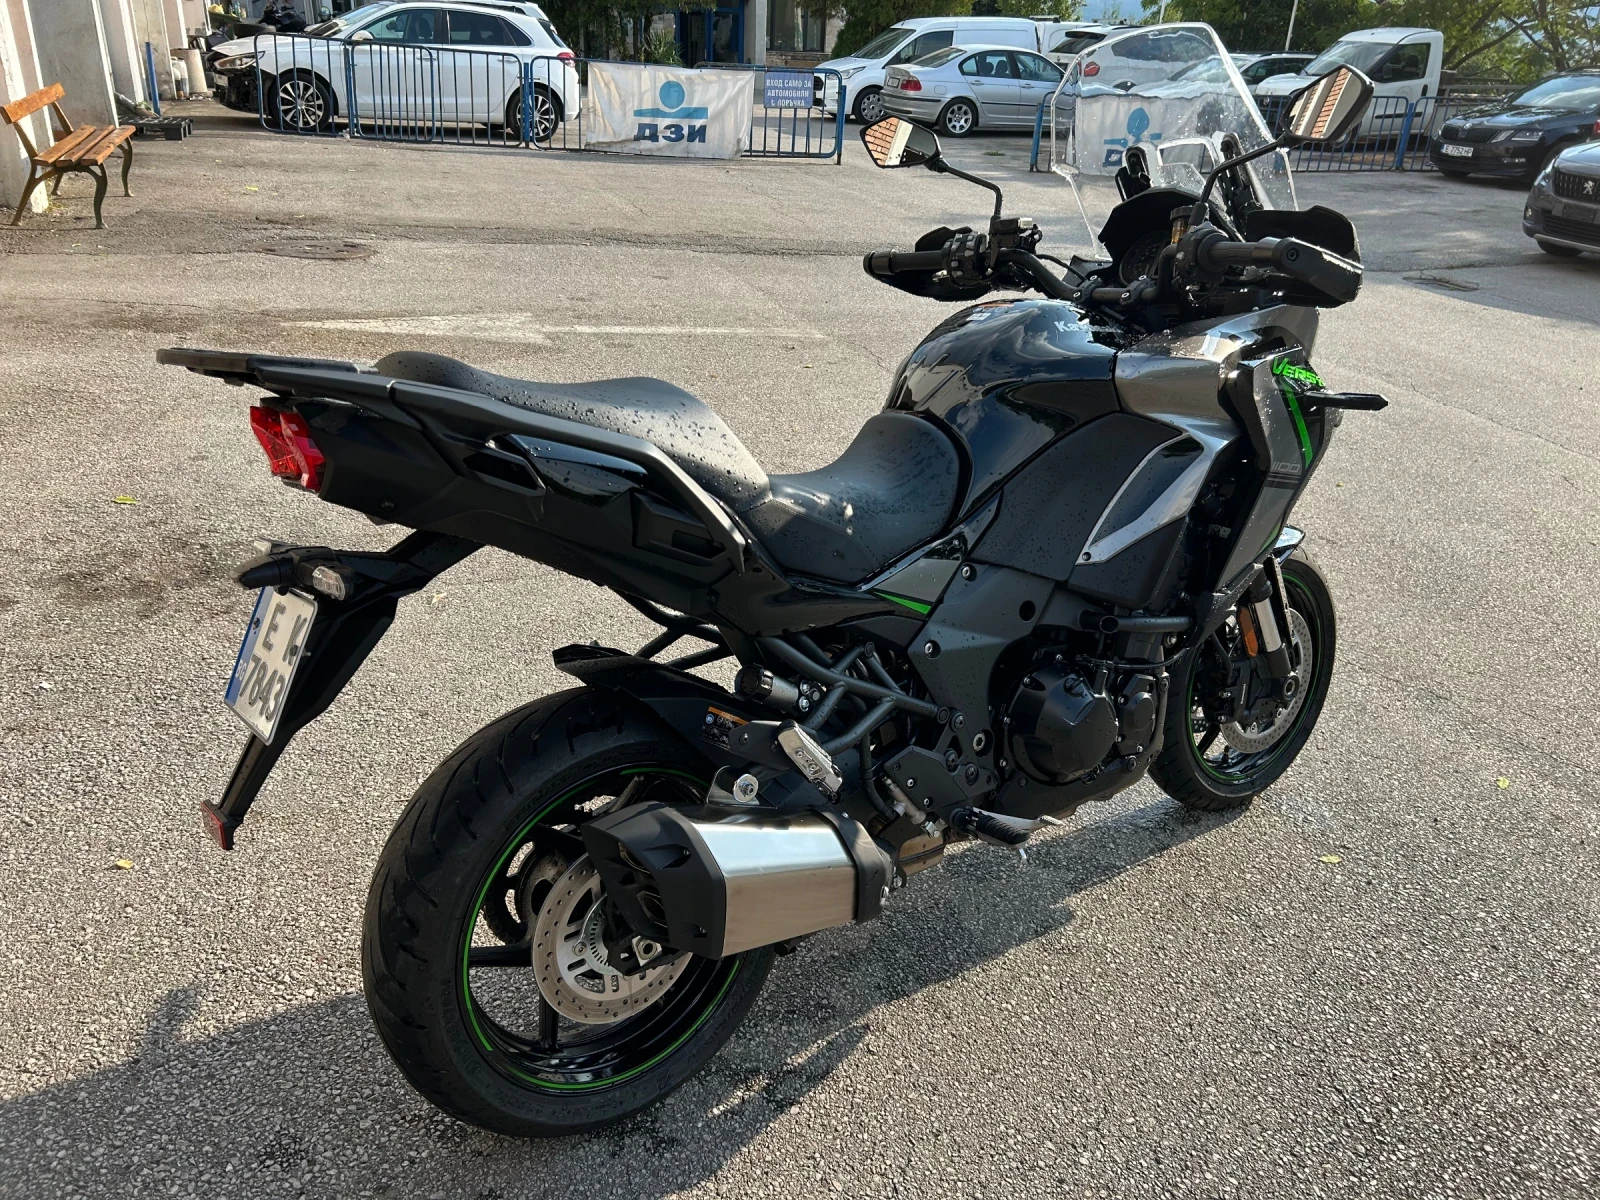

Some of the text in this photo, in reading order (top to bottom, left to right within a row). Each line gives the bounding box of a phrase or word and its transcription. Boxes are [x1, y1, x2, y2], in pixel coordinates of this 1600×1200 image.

[766, 79, 812, 88] ВХОД САМО ЗА
[767, 89, 809, 98] АВТОМОБИЛИ
[771, 99, 805, 107] С ПОРЪЧКА
[633, 122, 708, 144] ДЗИ
[234, 658, 248, 682] BG
[239, 652, 287, 723] 7843
